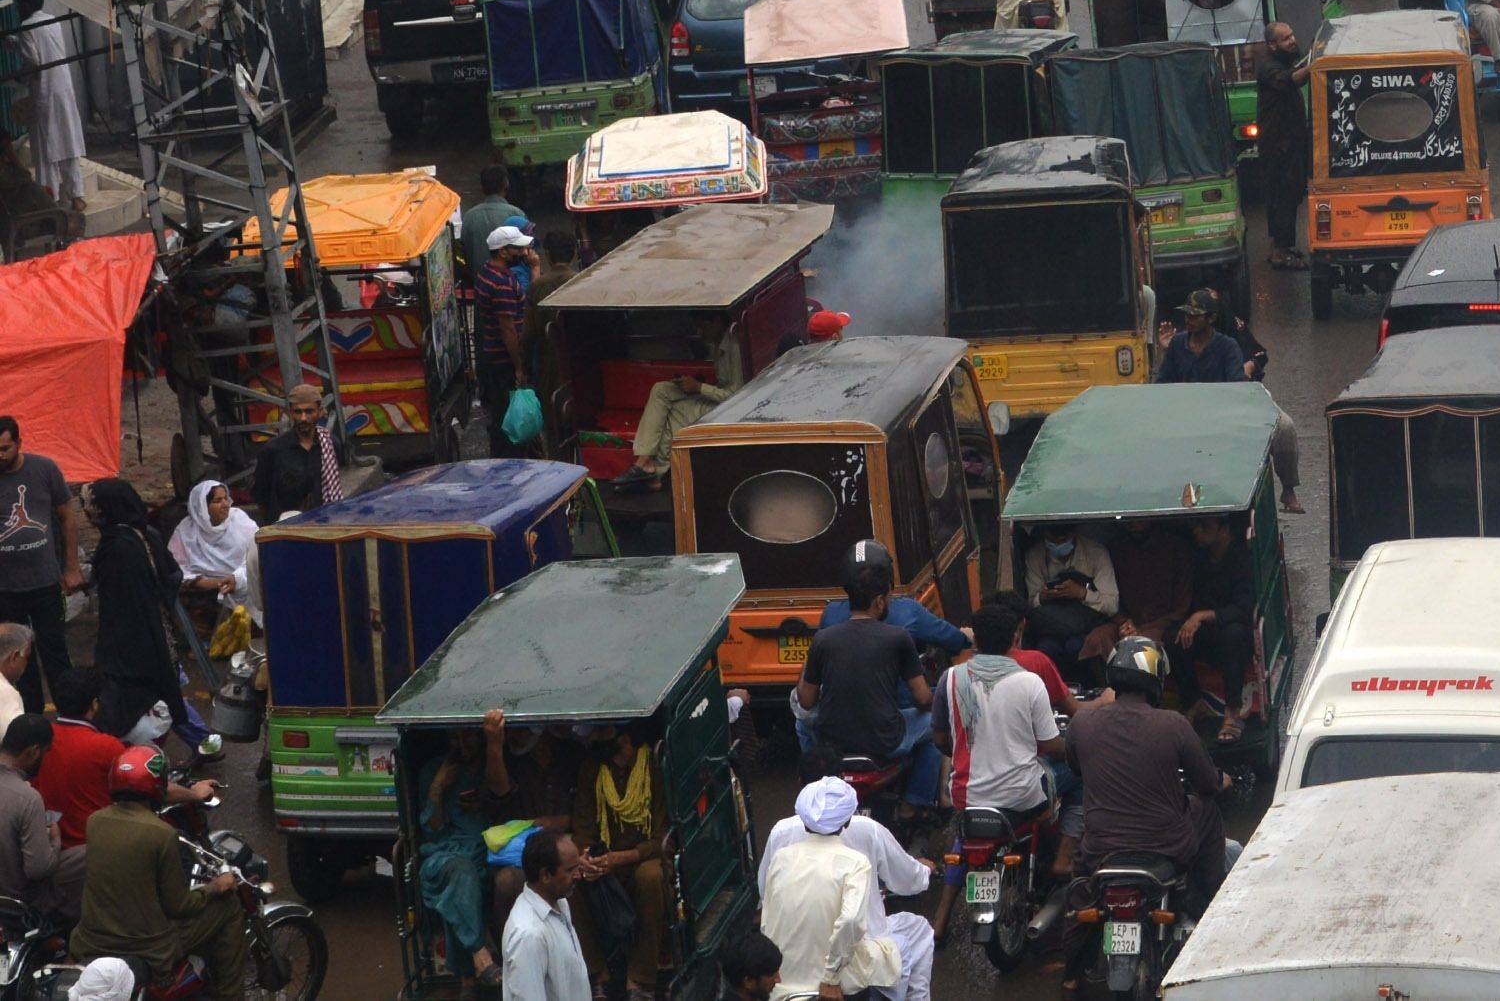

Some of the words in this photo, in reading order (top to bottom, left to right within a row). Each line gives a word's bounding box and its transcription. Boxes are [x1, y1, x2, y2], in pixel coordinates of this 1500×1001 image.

[1371, 75, 1415, 88] SIWA
[979, 367, 1004, 377] 2929
[1351, 676, 1495, 697] albayrak
[975, 877, 993, 887] LEM
[975, 888, 997, 900] 6199
[1112, 924, 1127, 937] LEP
